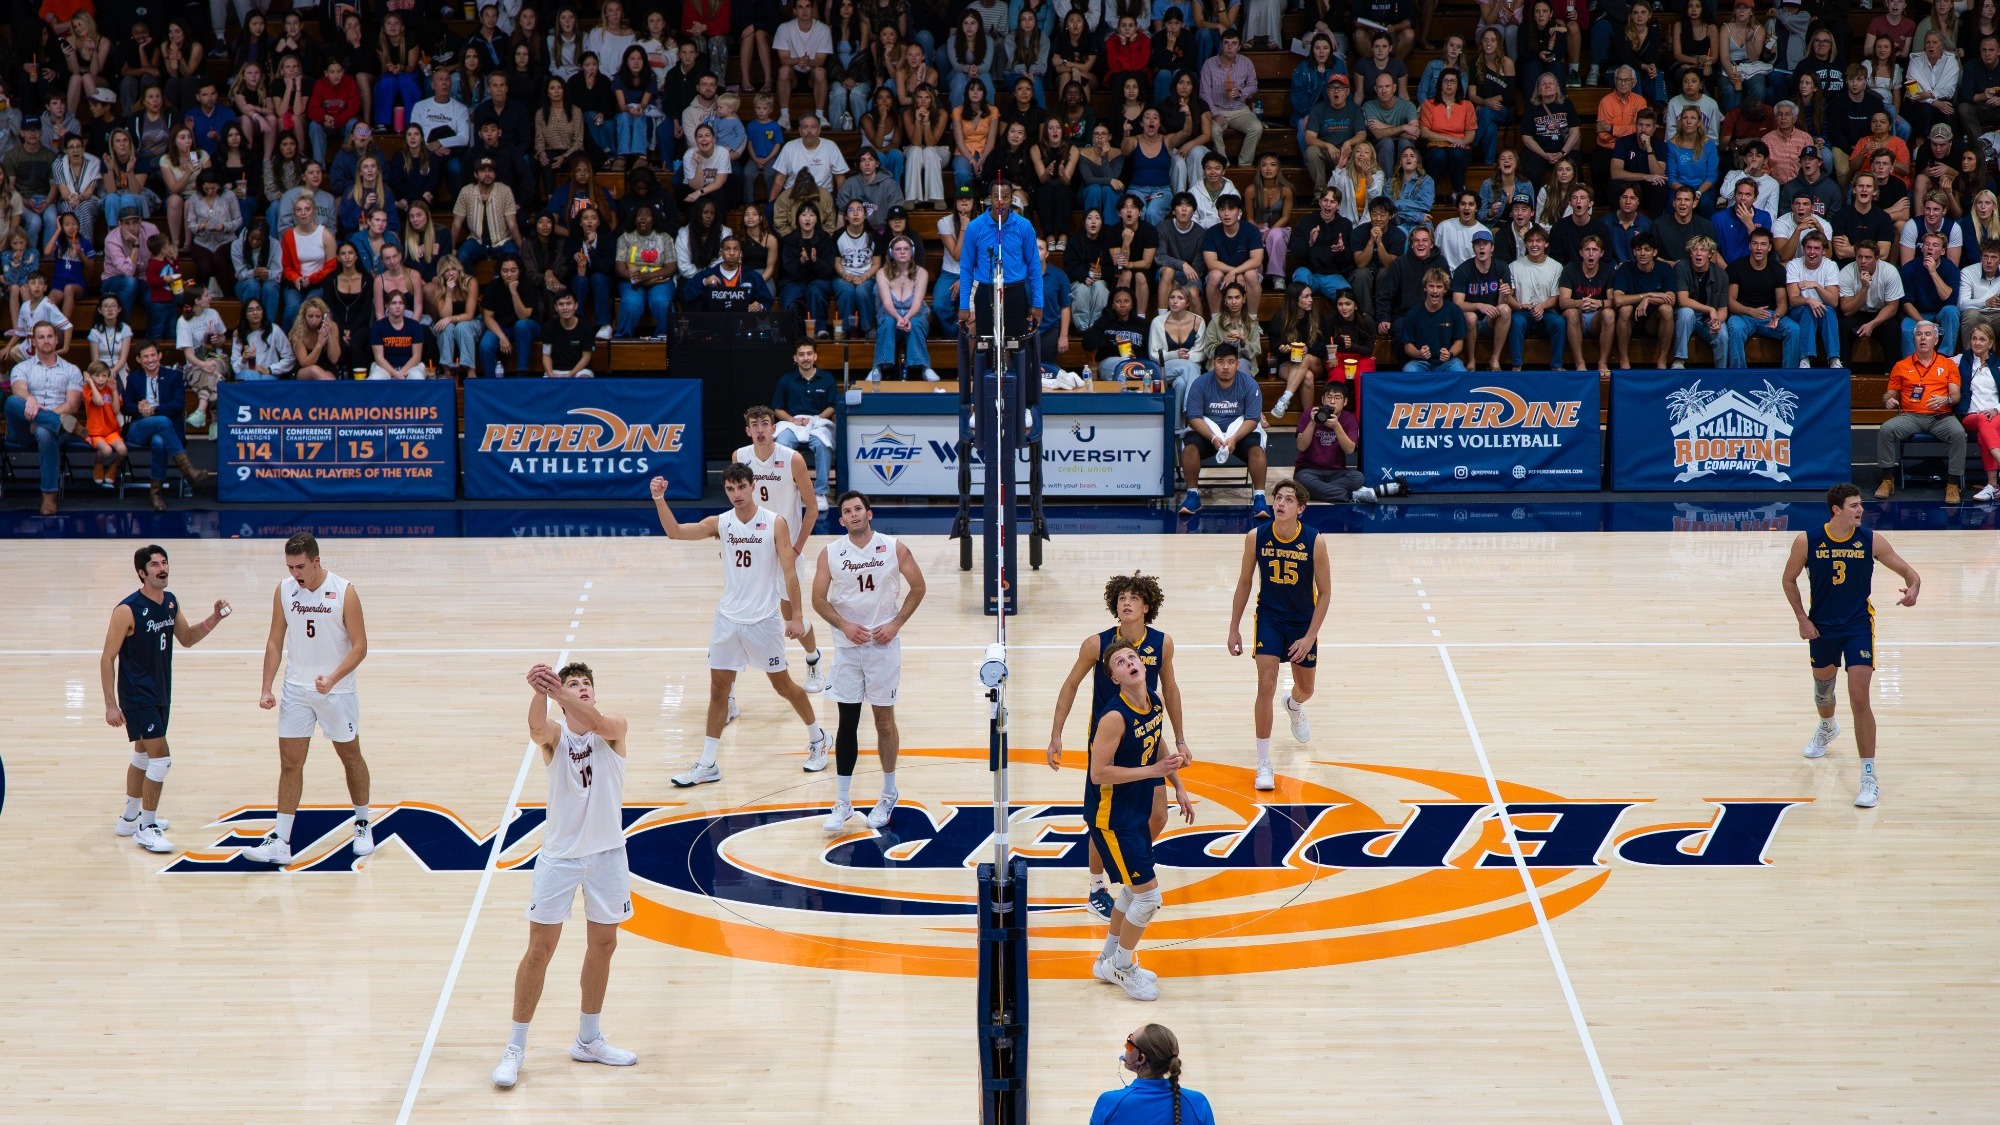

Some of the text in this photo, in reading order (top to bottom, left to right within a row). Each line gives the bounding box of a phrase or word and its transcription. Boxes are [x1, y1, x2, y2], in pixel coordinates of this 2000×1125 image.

[712, 291, 745, 299] ROMAR
[1937, 367, 1944, 376] P
[237, 406, 438, 422] 5 NCAA CHAMPIONSHIPS
[1387, 387, 1581, 429] PEPPERDINE
[478, 408, 686, 453] PEPPERDINE
[1699, 412, 1764, 436] MALIBU
[339, 428, 383, 437] OLYMPIANS
[1401, 434, 1561, 449] MEN'S VOLLEYBALL
[236, 442, 272, 460] 114
[295, 442, 323, 460] 17
[348, 441, 374, 459] 15
[400, 441, 428, 459] 16
[856, 447, 922, 459] MPSF
[1672, 437, 1791, 467] ROOFING
[509, 457, 648, 474] ATHLETICS
[1058, 464, 1084, 473] credit
[1704, 461, 1758, 470] COMPANY
[237, 466, 433, 481] 9 NATIONAL PLAYERS OF THE YEAR
[760, 486, 769, 502] 9
[727, 533, 763, 546] Pepperdine
[736, 550, 752, 568] 26
[1261, 548, 1308, 561] UC IRVINE
[1816, 549, 1864, 559] UC IRVINE
[842, 557, 884, 571] Pepperdine
[1268, 560, 1299, 585] 15
[1832, 560, 1846, 586] 3
[856, 574, 875, 592] 14
[291, 601, 332, 616] Pepperdine
[306, 620, 315, 638] 5
[160, 633, 167, 651] 6
[769, 657, 780, 667] 26
[348, 722, 353, 732] 5
[1134, 726, 1145, 739] UC
[624, 901, 630, 913] 10
